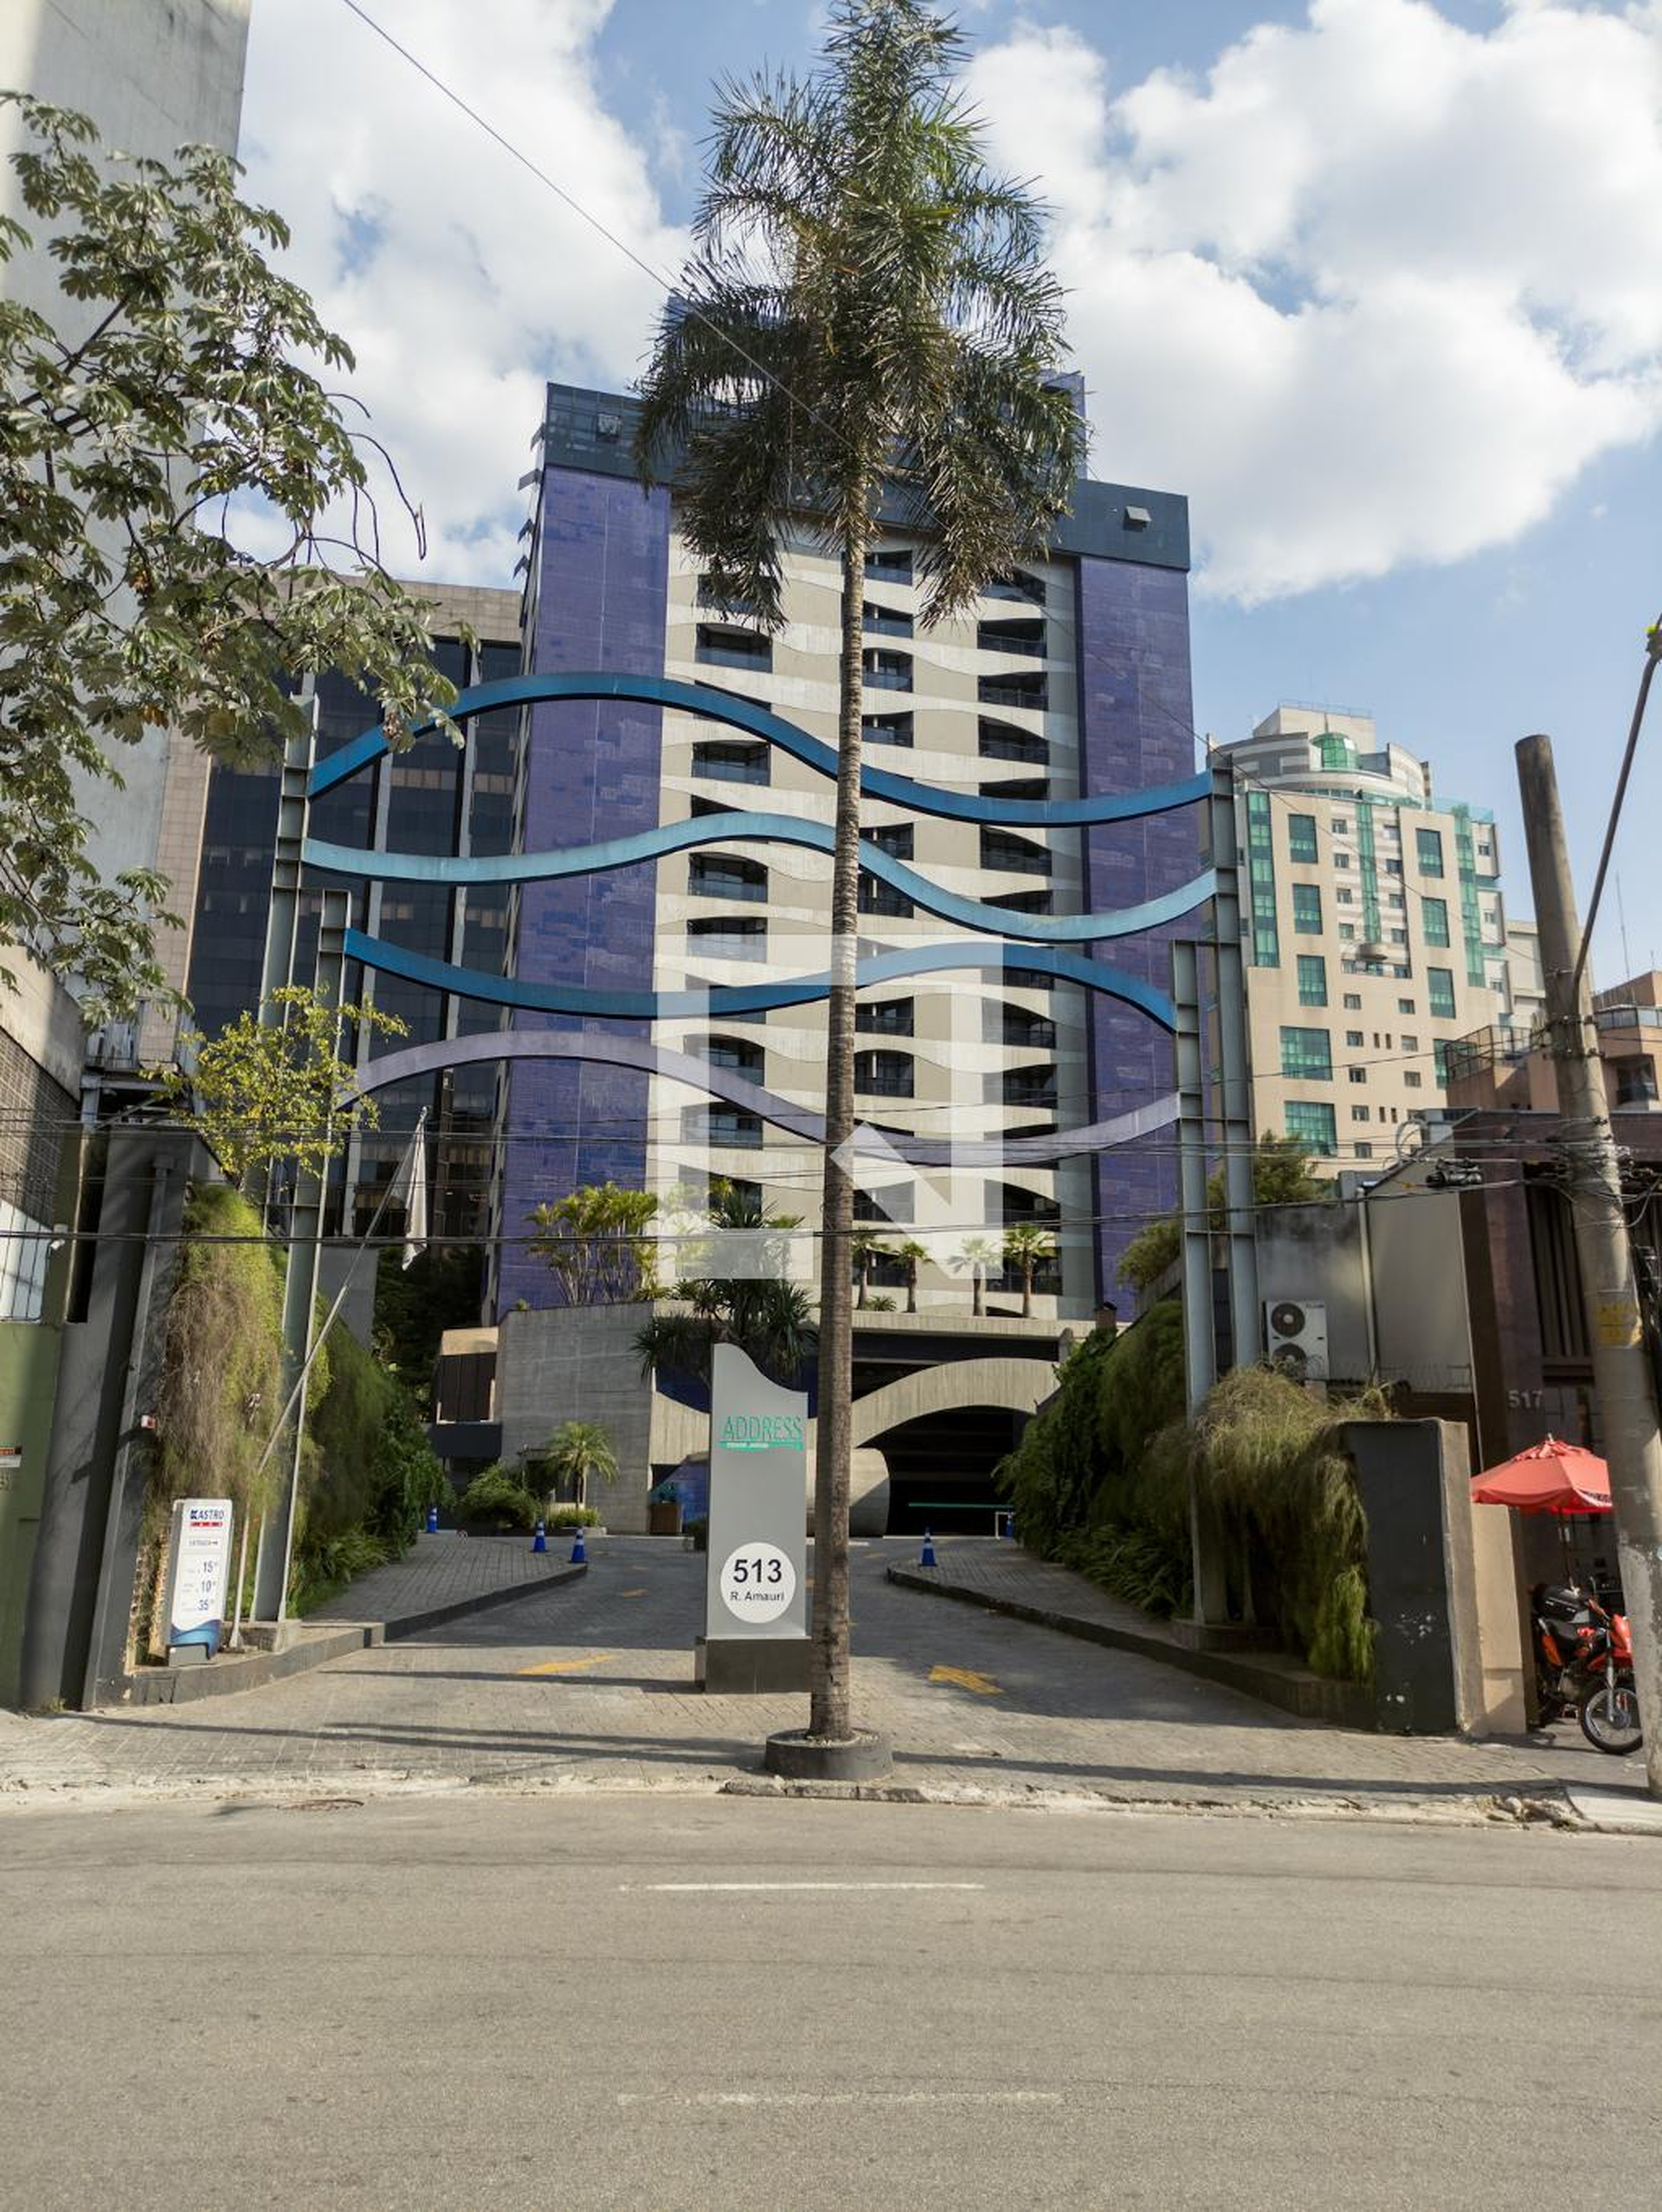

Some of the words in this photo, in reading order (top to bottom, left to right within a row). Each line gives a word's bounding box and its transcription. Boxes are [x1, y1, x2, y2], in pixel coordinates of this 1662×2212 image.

[1509, 1389, 1542, 1408] 517
[723, 1416, 802, 1441] ADDRESS
[733, 1558, 782, 1583] 513
[731, 1591, 741, 1600] R.
[745, 1591, 785, 1601] Amauri
